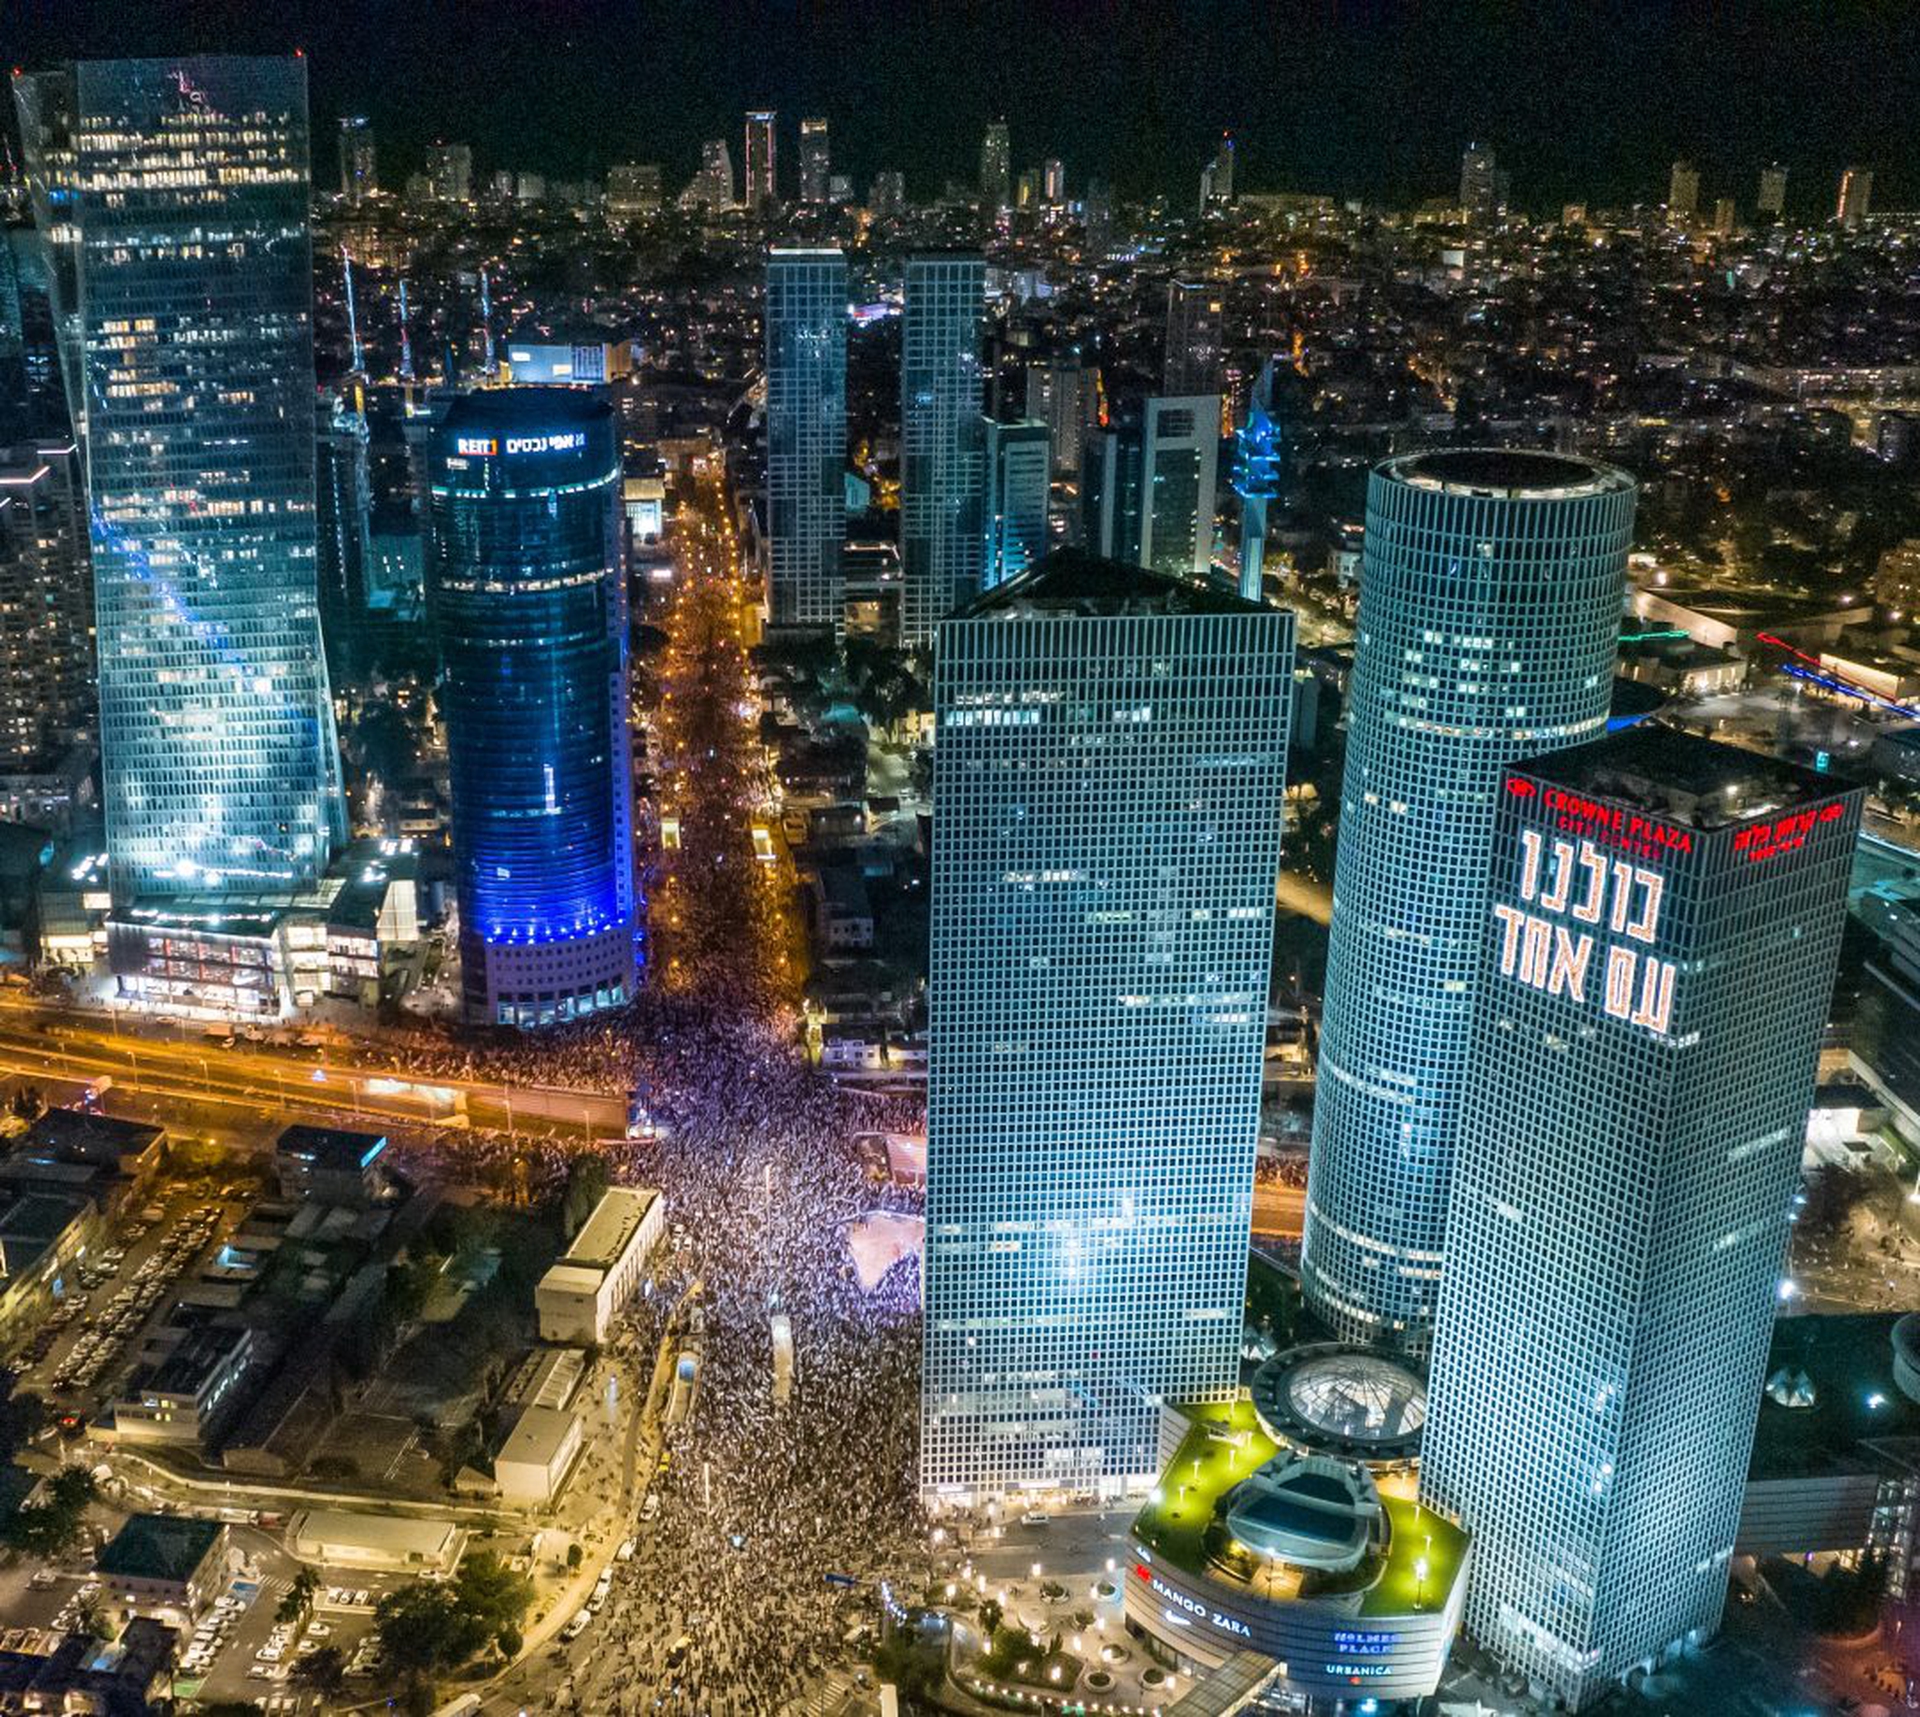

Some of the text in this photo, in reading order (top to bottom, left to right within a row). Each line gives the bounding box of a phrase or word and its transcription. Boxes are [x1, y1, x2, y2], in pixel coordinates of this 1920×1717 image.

[506, 437, 547, 454] נכסים
[1544, 787, 1692, 853] CROWNE PLAZA
[1521, 830, 1664, 943] כולנו
[1495, 904, 1676, 1034] עם אחד
[1152, 1579, 1251, 1637] MANGO ZARA
[1326, 1664, 1392, 1675] URBANICA
